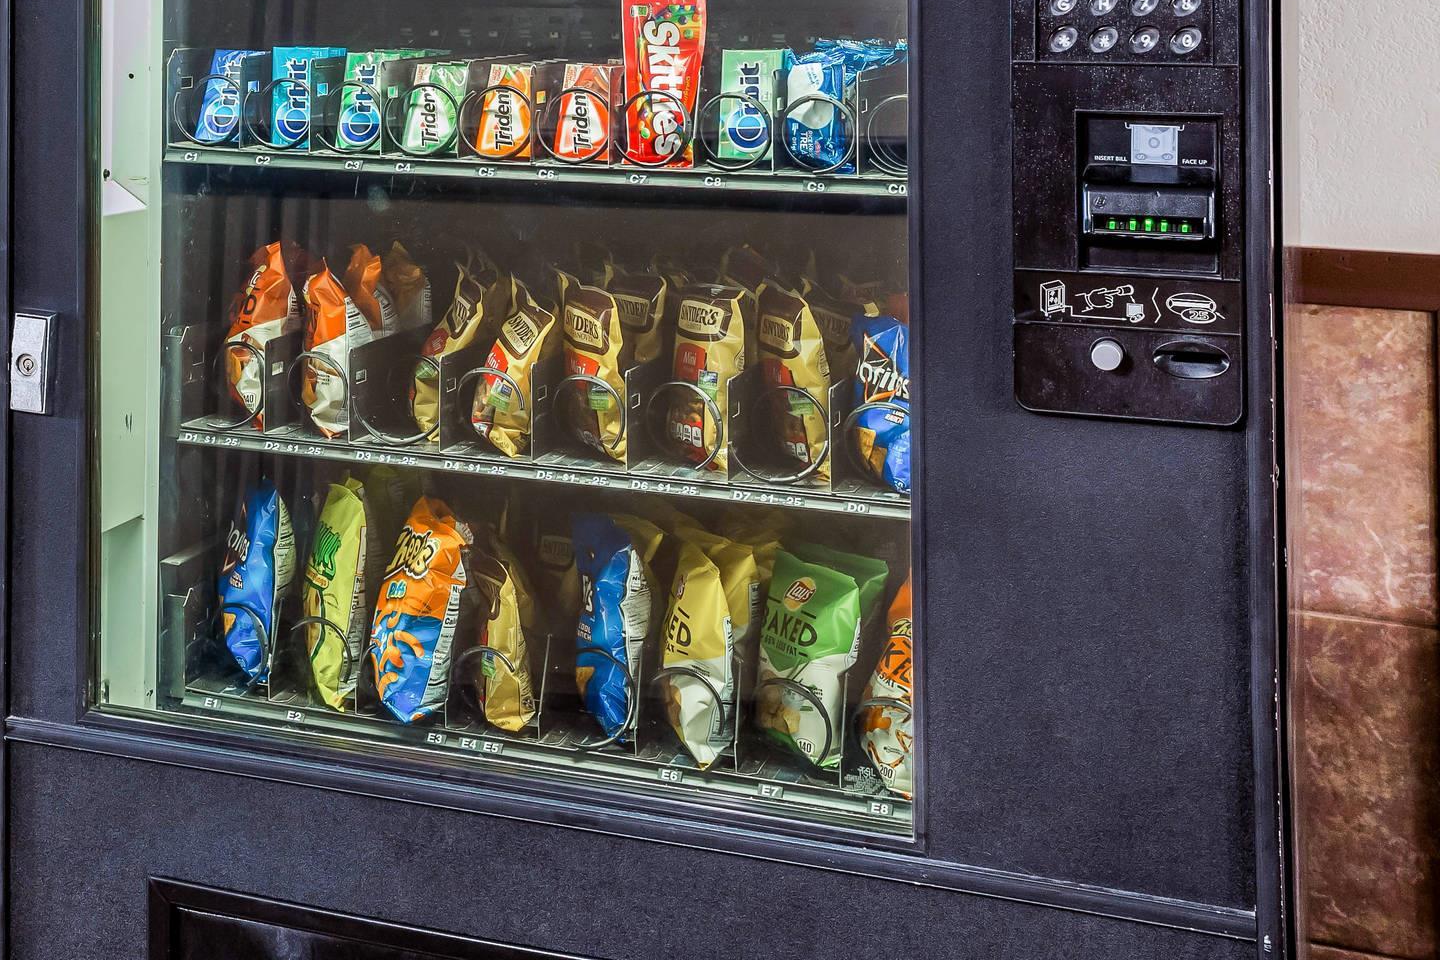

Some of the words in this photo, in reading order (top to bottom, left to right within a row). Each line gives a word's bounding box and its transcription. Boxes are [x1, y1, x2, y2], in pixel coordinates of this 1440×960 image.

[1057, 0, 1069, 10] G
[1098, 0, 1109, 10] H
[1140, 35, 1150, 47] 9
[1182, 35, 1192, 47] 0
[643, 21, 684, 155] Skittles
[495, 89, 511, 151] Trident
[572, 92, 589, 154] Trident
[184, 153, 198, 161] C1
[255, 156, 270, 165] C2
[344, 161, 359, 169] C3
[395, 163, 410, 172] C4
[478, 168, 494, 176] C5
[538, 170, 555, 179] C6
[629, 175, 647, 184] C7
[704, 177, 722, 187] C8
[807, 182, 825, 192] C9
[888, 184, 906, 194] C0
[680, 304, 719, 327] SNYDER'S
[1189, 311, 1210, 320] 25
[683, 351, 697, 364] Mini
[184, 434, 198, 442] D1
[264, 442, 279, 450] D2
[356, 451, 371, 460] D3
[443, 461, 459, 470] D4
[536, 470, 553, 480] D5
[632, 480, 648, 490] D6
[733, 490, 750, 500] D7
[847, 503, 865, 513] D0
[786, 581, 813, 601] Lay's
[762, 606, 817, 647] BAKED
[204, 698, 218, 708] E1
[287, 711, 301, 721] E2
[427, 733, 442, 743] E3
[462, 739, 477, 749] E4
[484, 742, 499, 752] E5
[799, 740, 812, 753] 140
[661, 770, 678, 780] E6
[880, 764, 893, 778] 200
[761, 786, 779, 796] E7
[871, 803, 889, 814] E8
